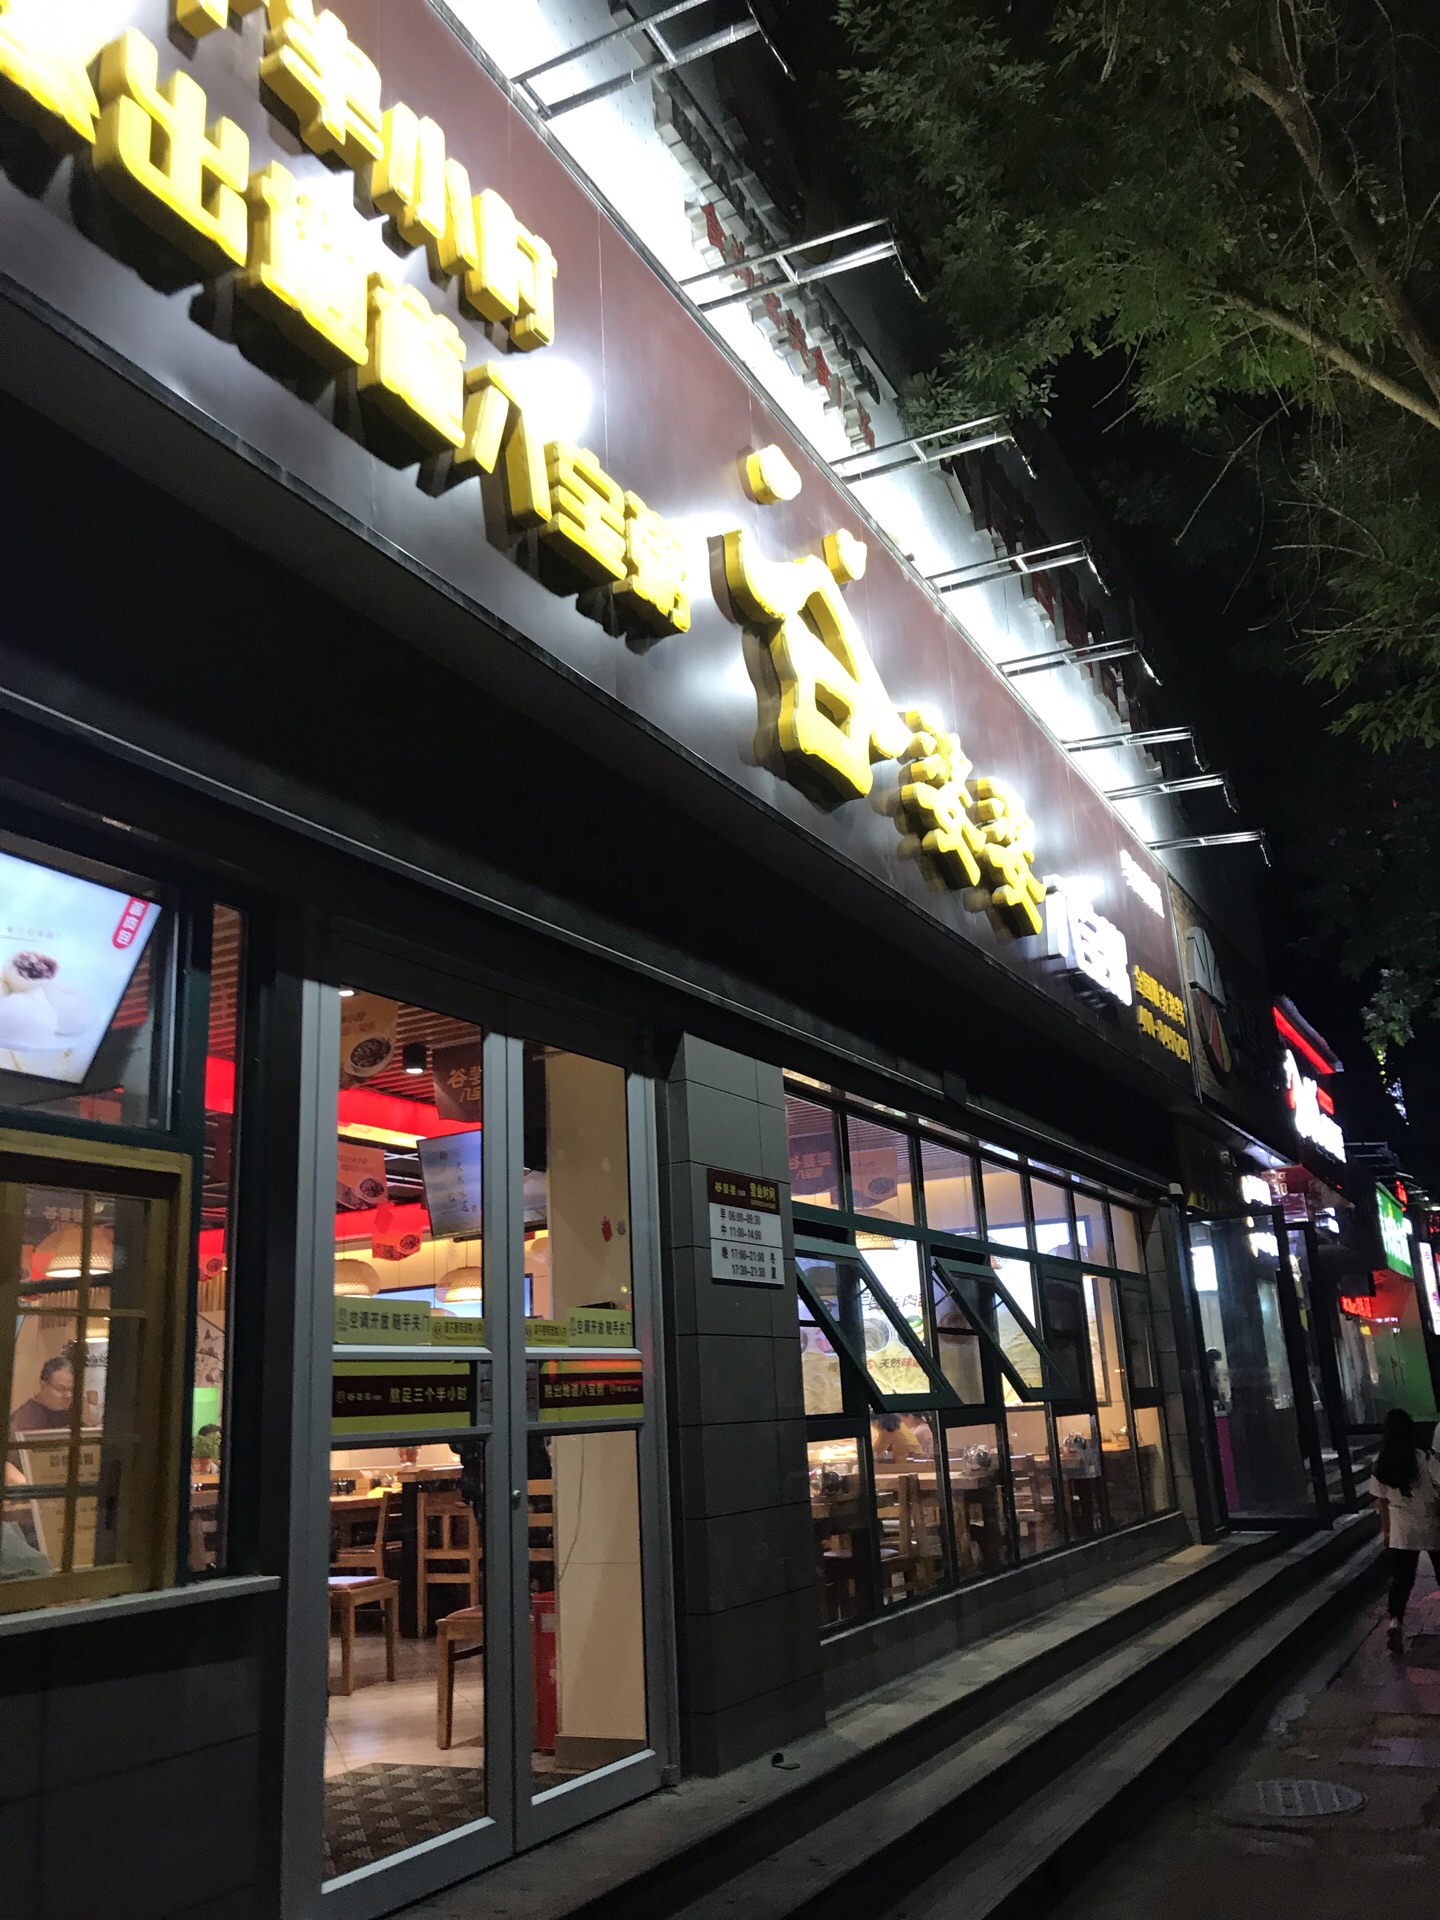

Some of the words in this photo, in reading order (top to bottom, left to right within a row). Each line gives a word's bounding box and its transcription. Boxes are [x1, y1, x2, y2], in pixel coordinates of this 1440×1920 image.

[172, 0, 558, 352] 半小时
[720, 1223, 728, 1238] 中
[349, 1311, 389, 1330] 空调开放
[576, 1321, 605, 1335] 空调开放
[389, 1385, 468, 1404] 熬足三个半小时
